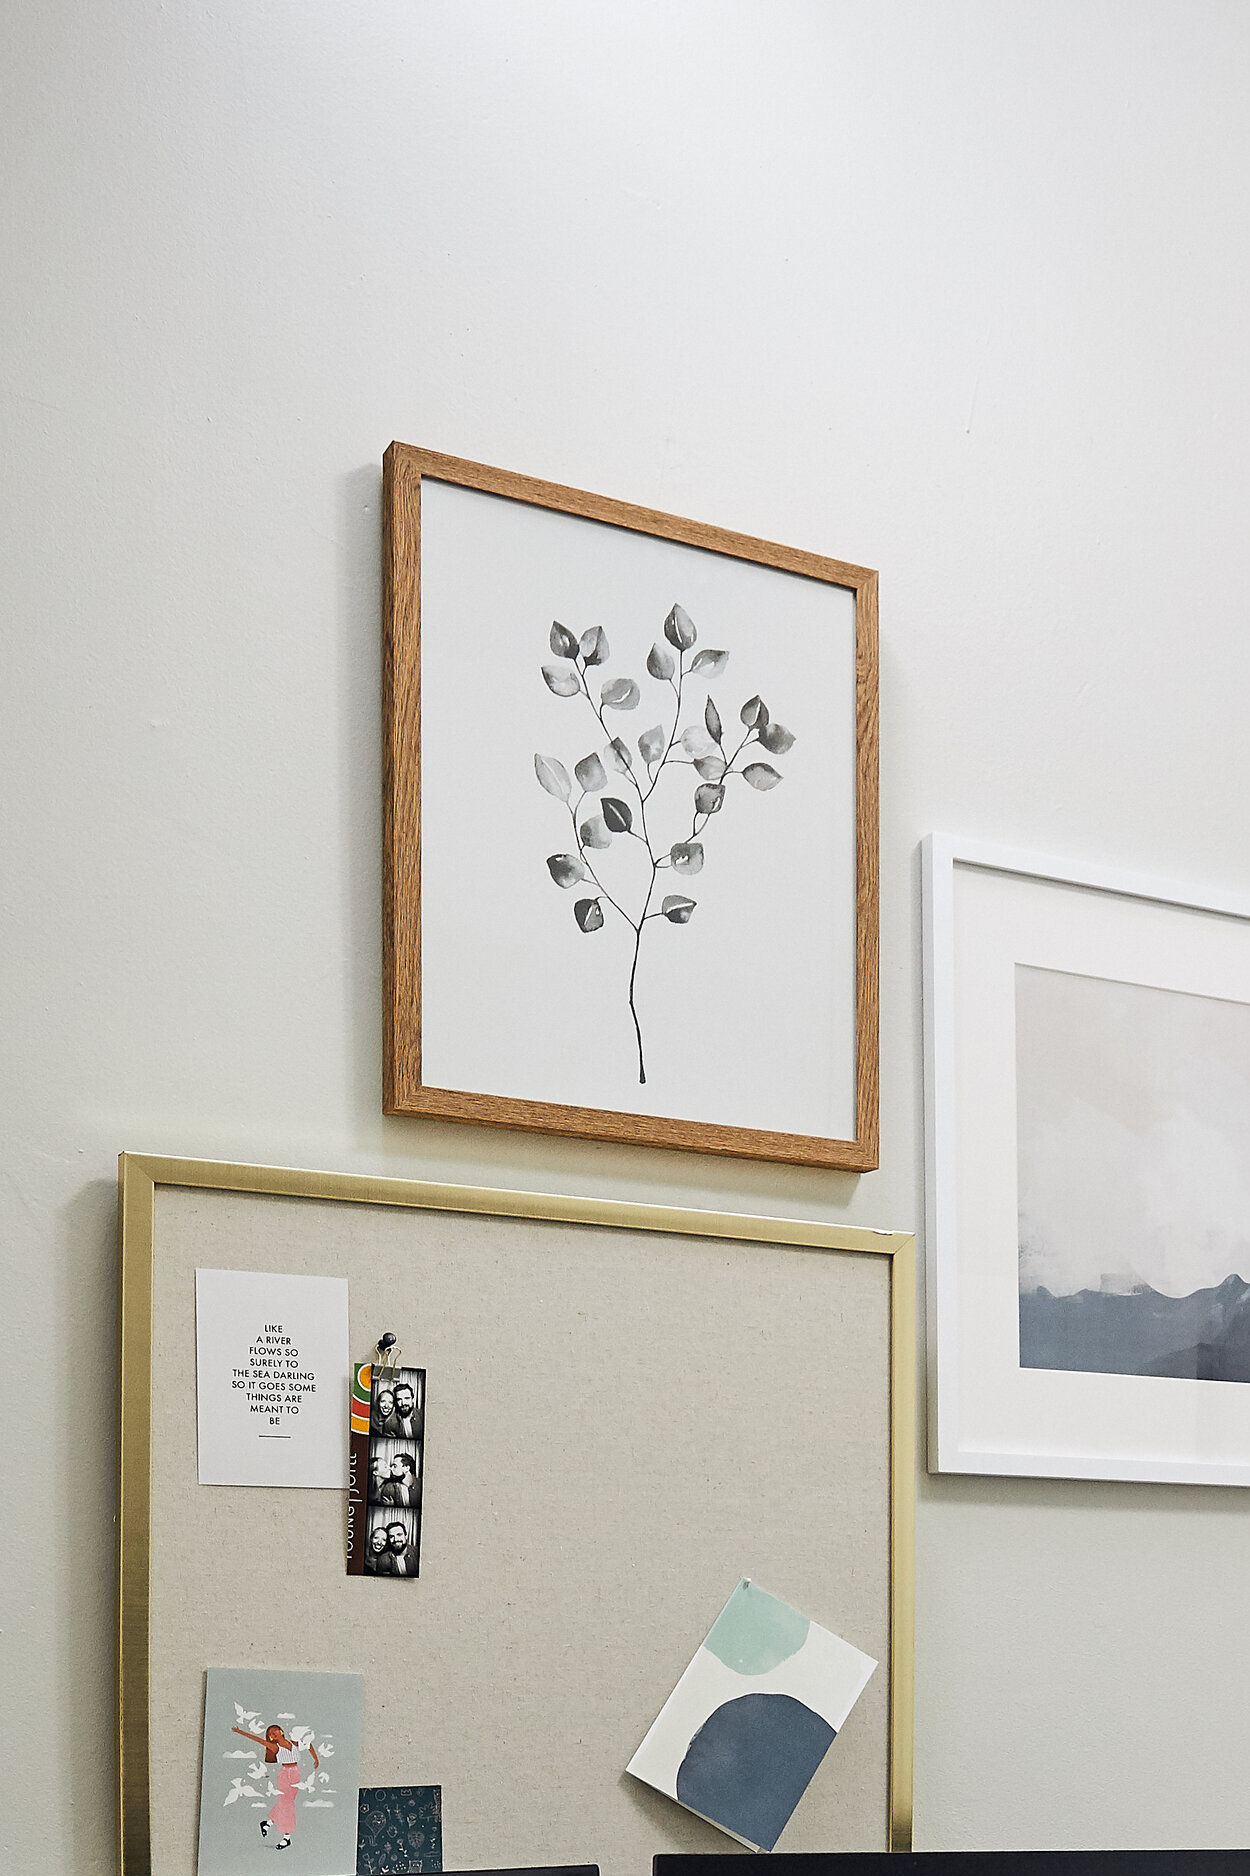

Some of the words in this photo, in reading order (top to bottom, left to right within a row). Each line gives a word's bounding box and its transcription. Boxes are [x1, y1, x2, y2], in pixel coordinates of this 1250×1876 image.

[264, 1324, 283, 1334] LIKE
[255, 1335, 263, 1344] A
[265, 1335, 292, 1346] RIVER
[249, 1346, 282, 1357] FLOWS
[284, 1348, 299, 1358] SO
[249, 1357, 284, 1368] SURELY
[285, 1359, 299, 1369] TO
[232, 1368, 250, 1378] THE
[252, 1369, 271, 1379] SEA
[273, 1370, 315, 1381] DARLING
[231, 1380, 246, 1390] SO
[248, 1381, 257, 1390] IT
[258, 1381, 286, 1391] GOES
[288, 1382, 317, 1393] SOME
[245, 1392, 282, 1403] THINGS
[284, 1394, 303, 1404] ARE
[249, 1404, 284, 1414] MEANT
[285, 1405, 300, 1415] TO
[269, 1416, 281, 1426] BE
